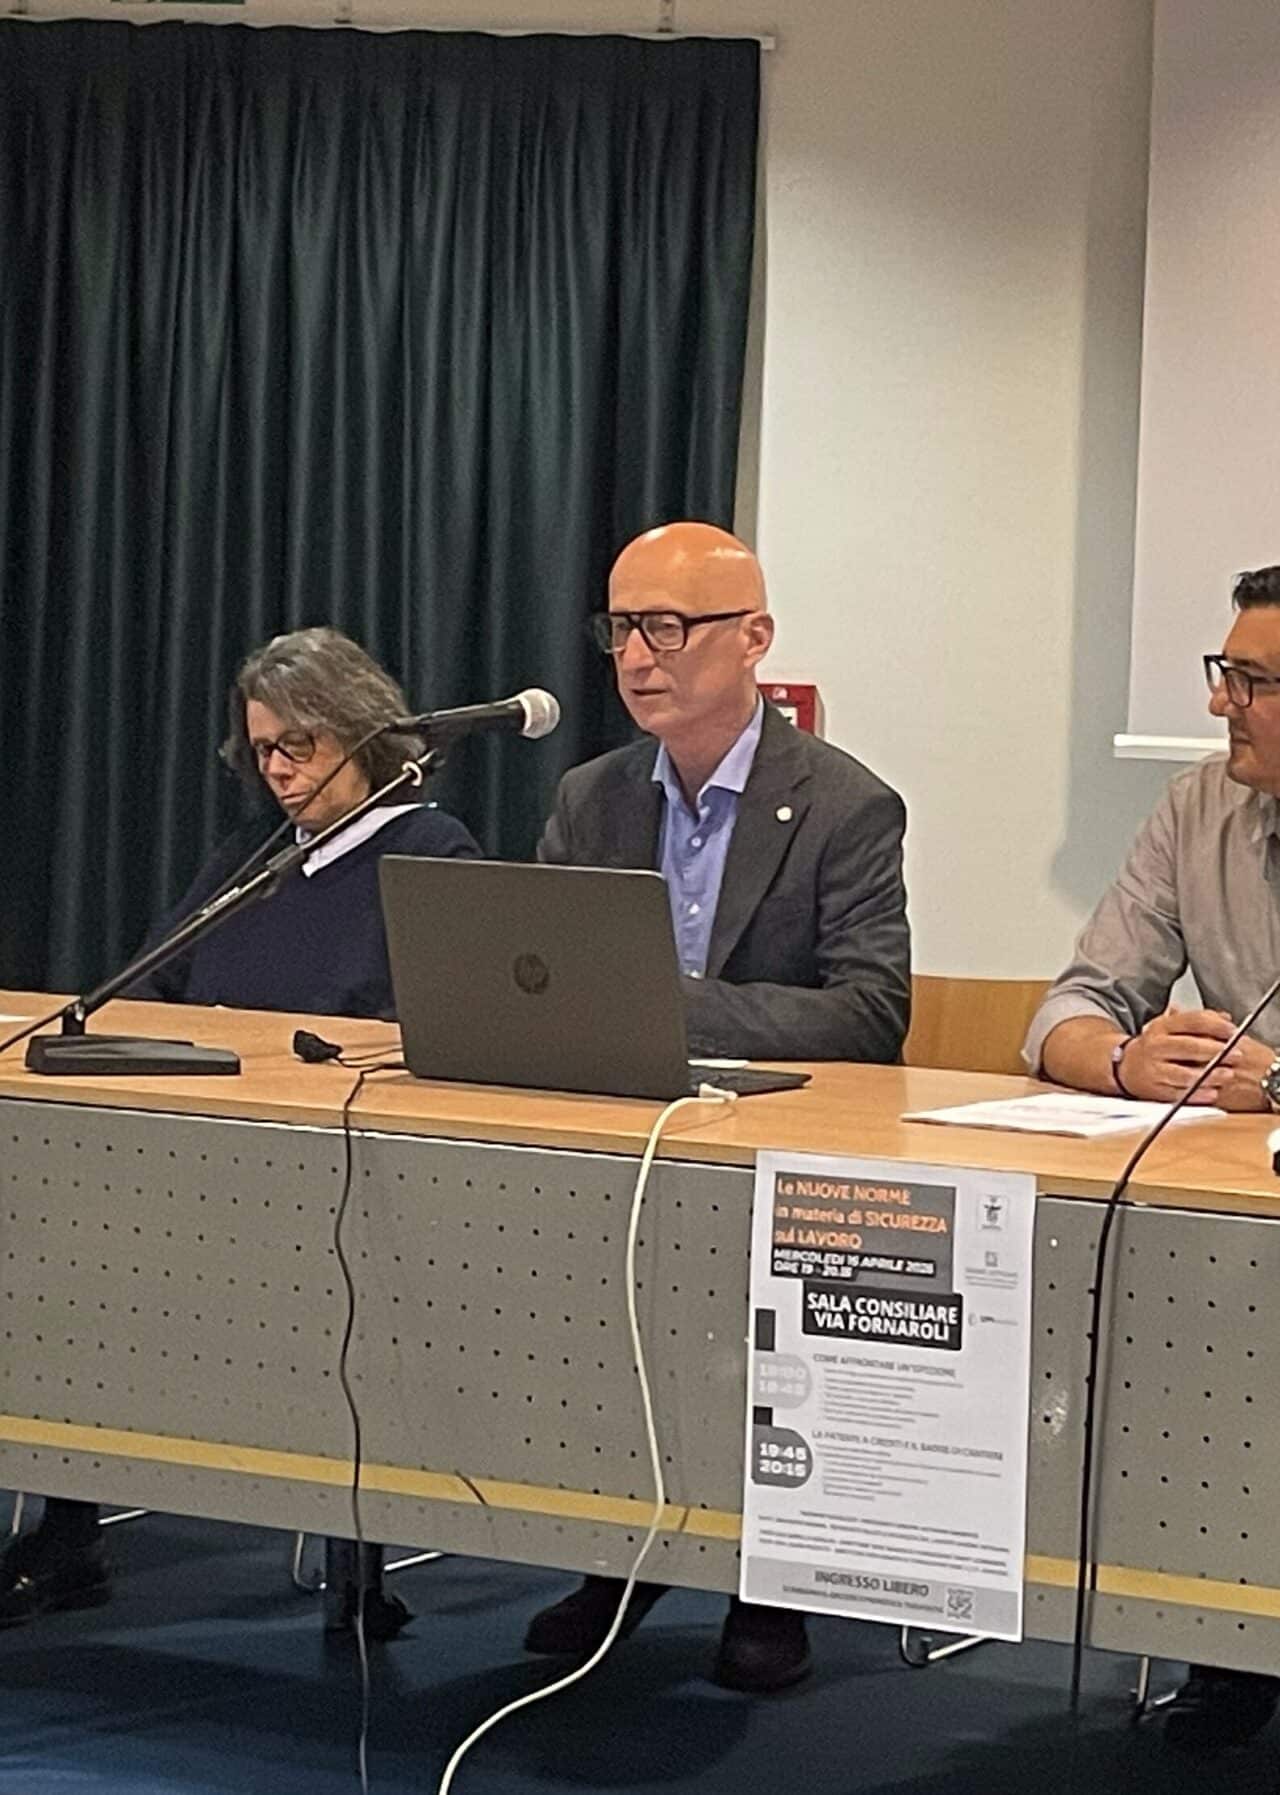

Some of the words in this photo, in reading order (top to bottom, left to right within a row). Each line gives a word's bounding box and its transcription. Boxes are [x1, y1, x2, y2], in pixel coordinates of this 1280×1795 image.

[776, 1179, 795, 1197] Le
[796, 1181, 851, 1200] NUOVE
[854, 1186, 912, 1206] NORME
[792, 1206, 845, 1225] materia
[848, 1210, 863, 1225] di
[866, 1211, 948, 1233] SICUREZZA
[798, 1230, 863, 1249] LAVORO
[773, 1260, 799, 1274] ORE
[860, 1256, 903, 1271] APRILE
[807, 1292, 852, 1314] SALA
[854, 1297, 959, 1325] CONSILIARE
[814, 1311, 845, 1330] VIA
[848, 1313, 949, 1341] FORNAROLI
[759, 1442, 806, 1461] 19:45
[759, 1459, 806, 1478] 20:15
[815, 1570, 881, 1592] INGRESSO
[882, 1578, 929, 1597] LIBERO
